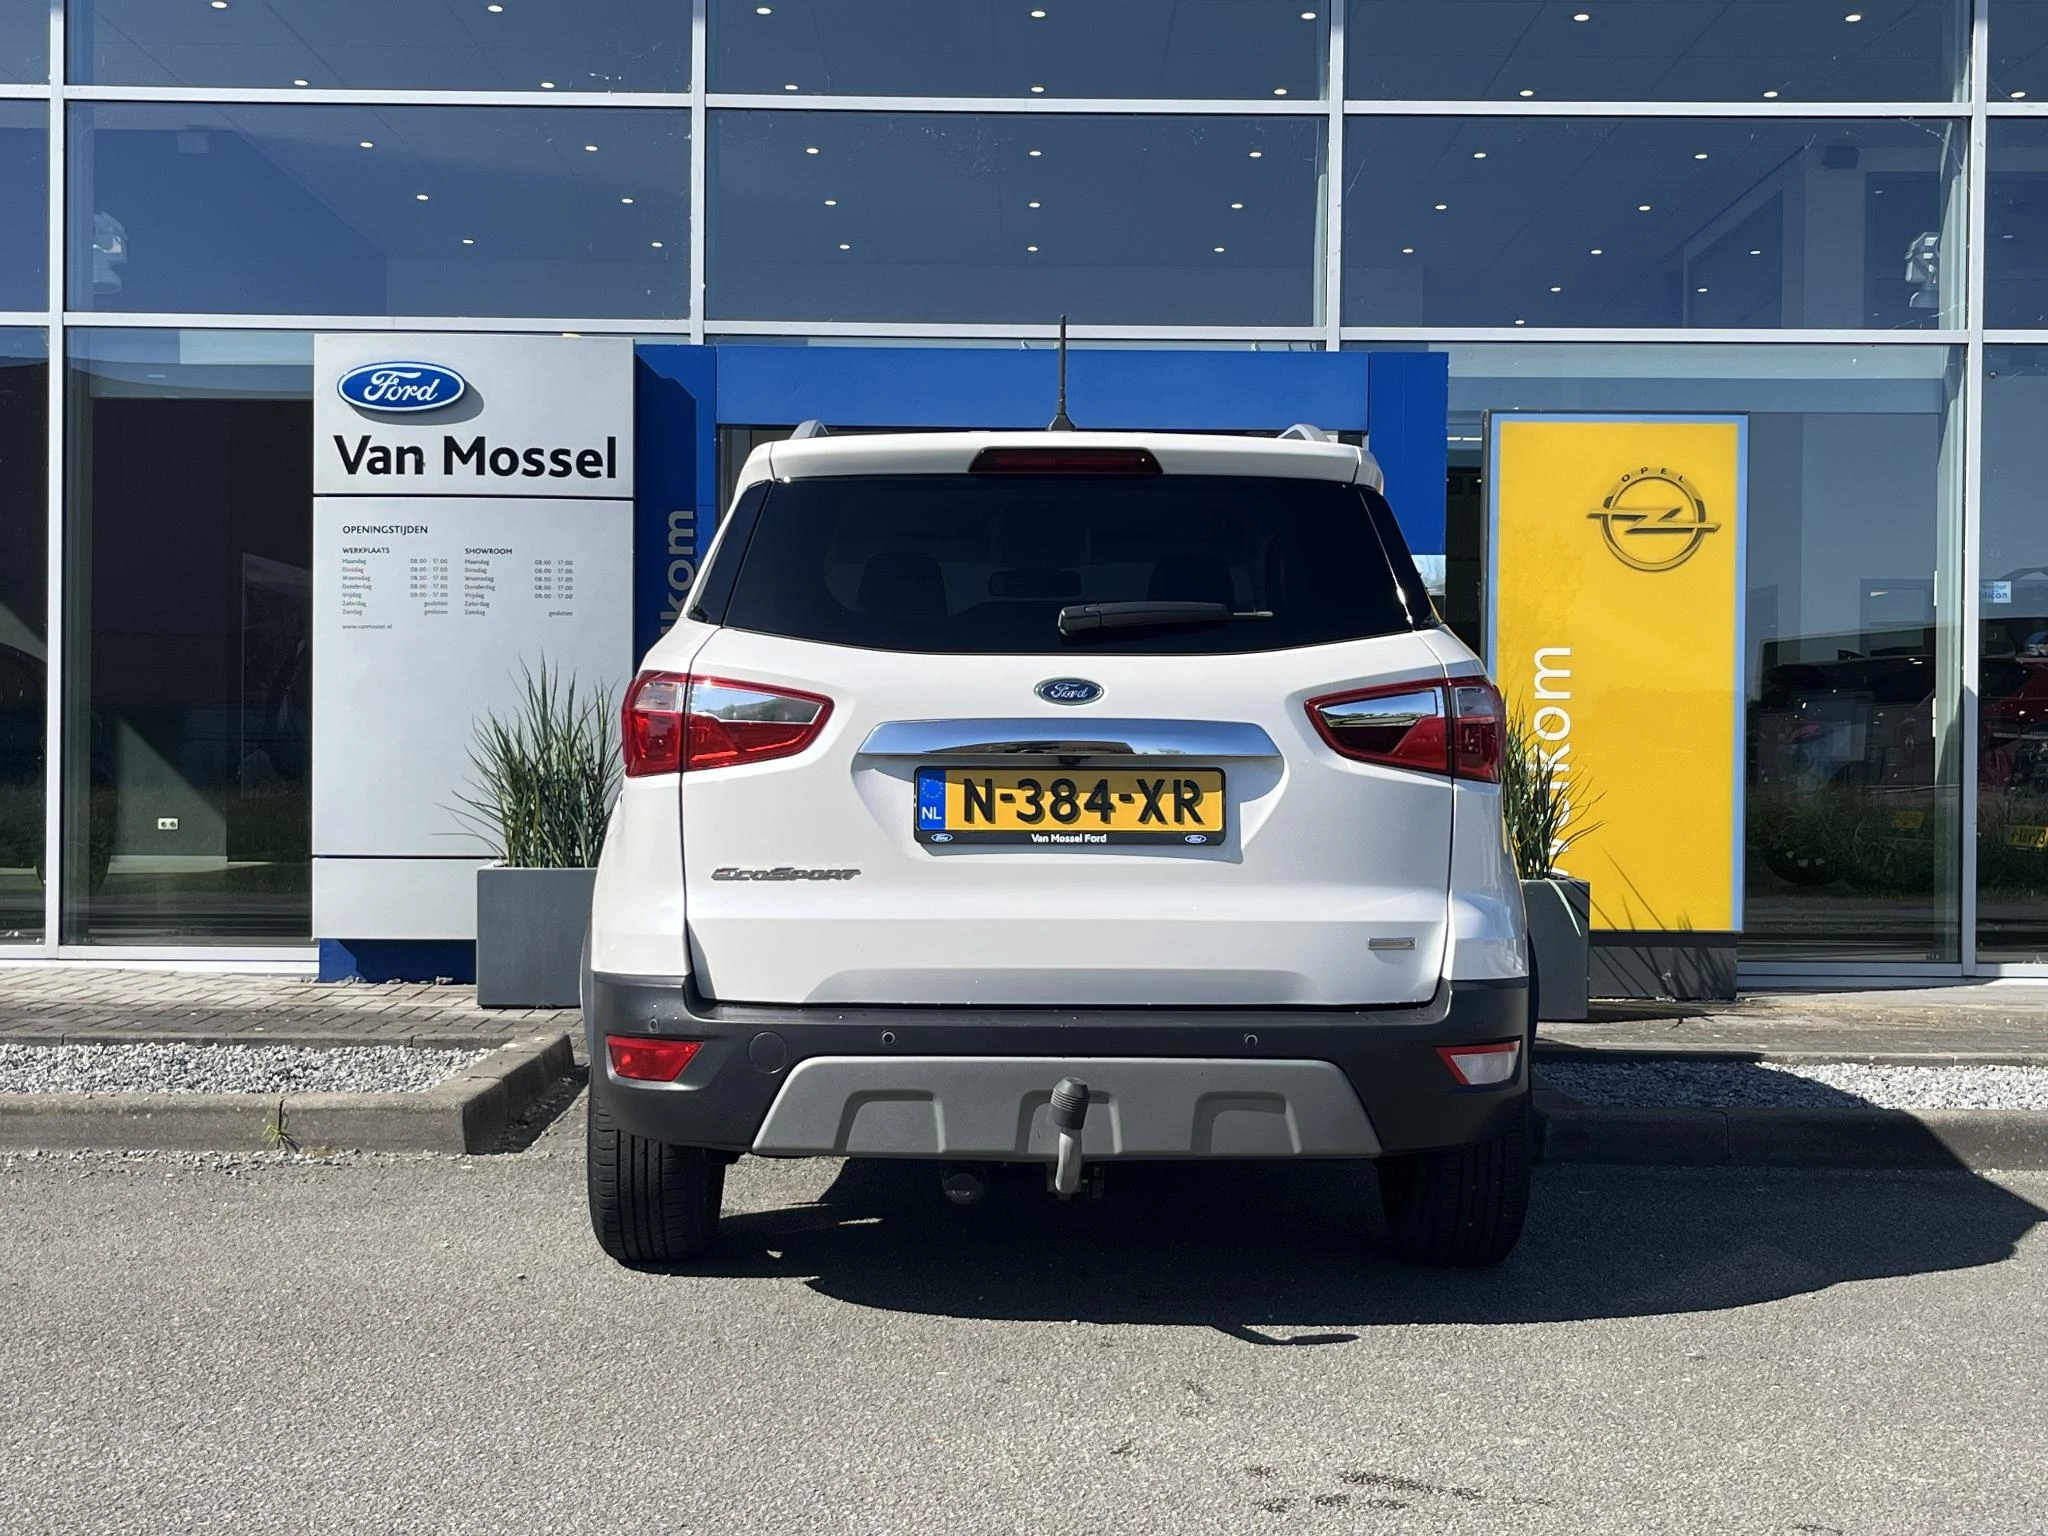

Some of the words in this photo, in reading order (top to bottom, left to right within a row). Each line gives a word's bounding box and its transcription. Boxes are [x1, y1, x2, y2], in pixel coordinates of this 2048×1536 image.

[363, 370, 441, 402] Ford
[333, 434, 424, 476] Van
[443, 435, 617, 479] Mossel
[1621, 466, 1685, 483] OPEL
[342, 525, 429, 536] OPENINGSTIJDEN
[963, 777, 1203, 823] N-384-XR
[921, 806, 942, 820] NL
[1031, 833, 1049, 843] Van
[1050, 833, 1083, 843] Mossel
[1084, 833, 1107, 843] Ford
